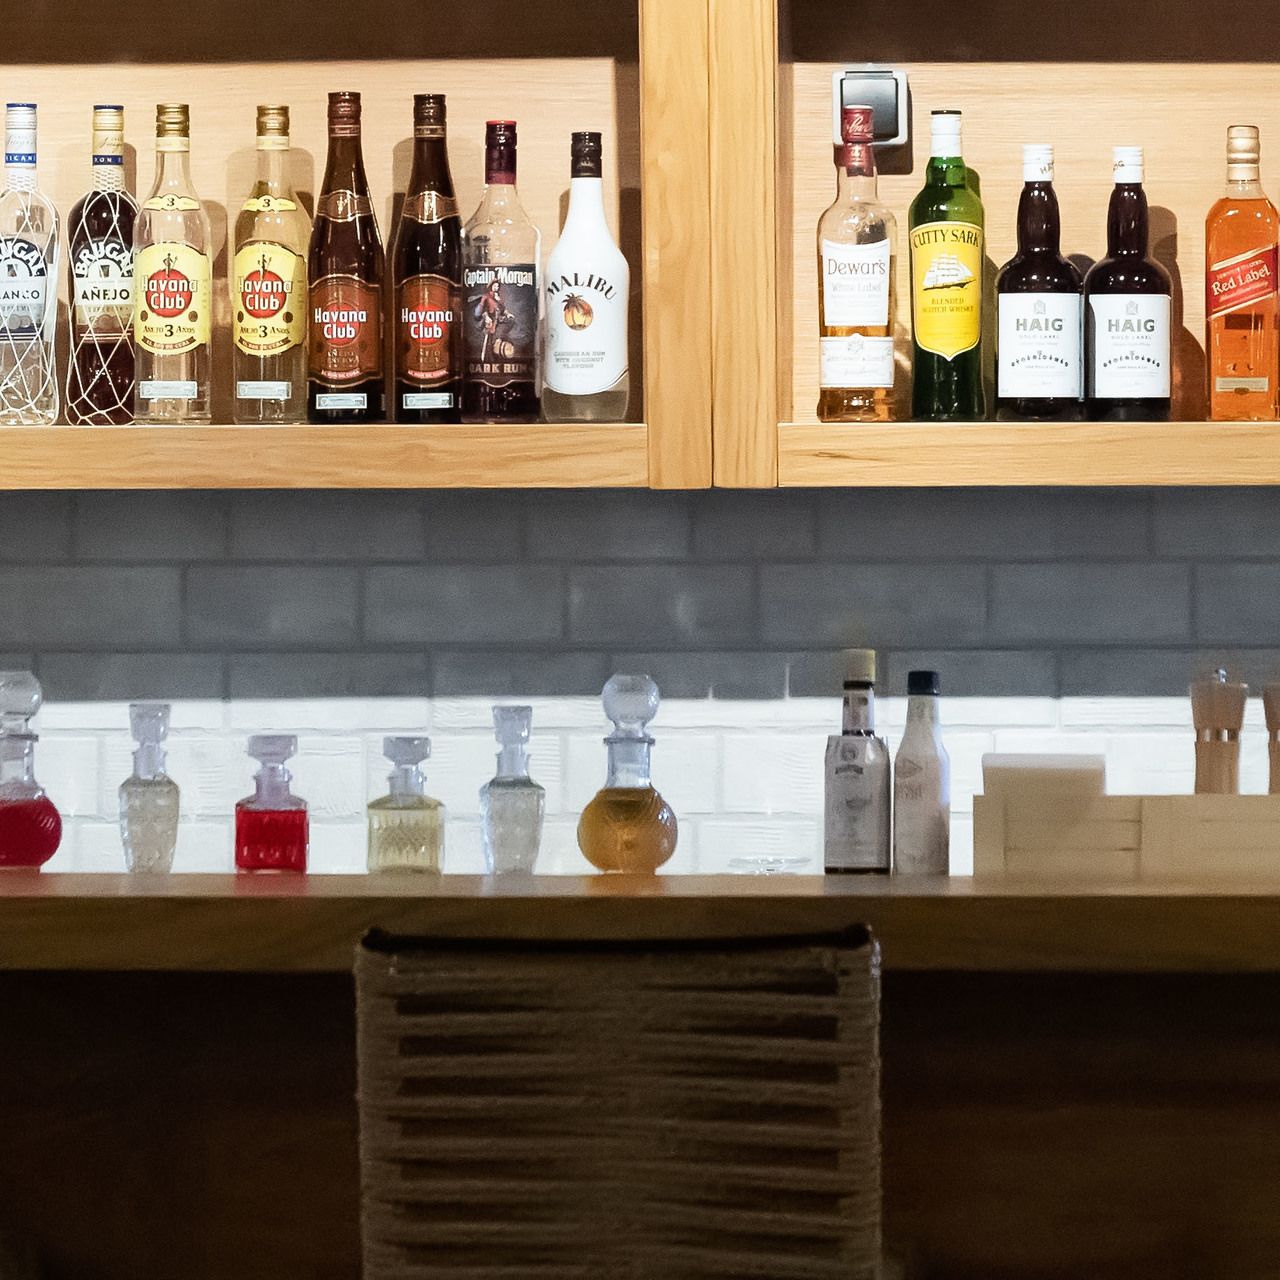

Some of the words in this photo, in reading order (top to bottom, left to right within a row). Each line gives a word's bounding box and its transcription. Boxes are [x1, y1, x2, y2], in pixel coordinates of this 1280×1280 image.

[166, 197, 175, 207] 3
[262, 198, 271, 207] 3
[913, 229, 947, 249] CUTTY
[951, 229, 979, 248] SARK
[827, 258, 886, 275] Dewar's
[142, 275, 198, 292] Havana
[239, 275, 292, 293] Havana
[464, 267, 496, 287] Captain
[494, 266, 533, 287] Morgan
[1211, 278, 1236, 296] Red
[1237, 264, 1272, 286] Label
[81, 286, 130, 301] AÑEJO
[547, 272, 617, 301] MALIBU
[150, 293, 185, 309] Club
[245, 294, 280, 310] Club
[931, 297, 965, 305] BLENDED
[314, 308, 367, 323] Havana
[402, 308, 453, 323] Havana
[164, 324, 174, 337] 3
[258, 325, 268, 338] 3
[323, 323, 356, 339] Club
[410, 323, 443, 339] Club
[1015, 318, 1063, 331] HAIG
[1107, 319, 1155, 332] HAIG
